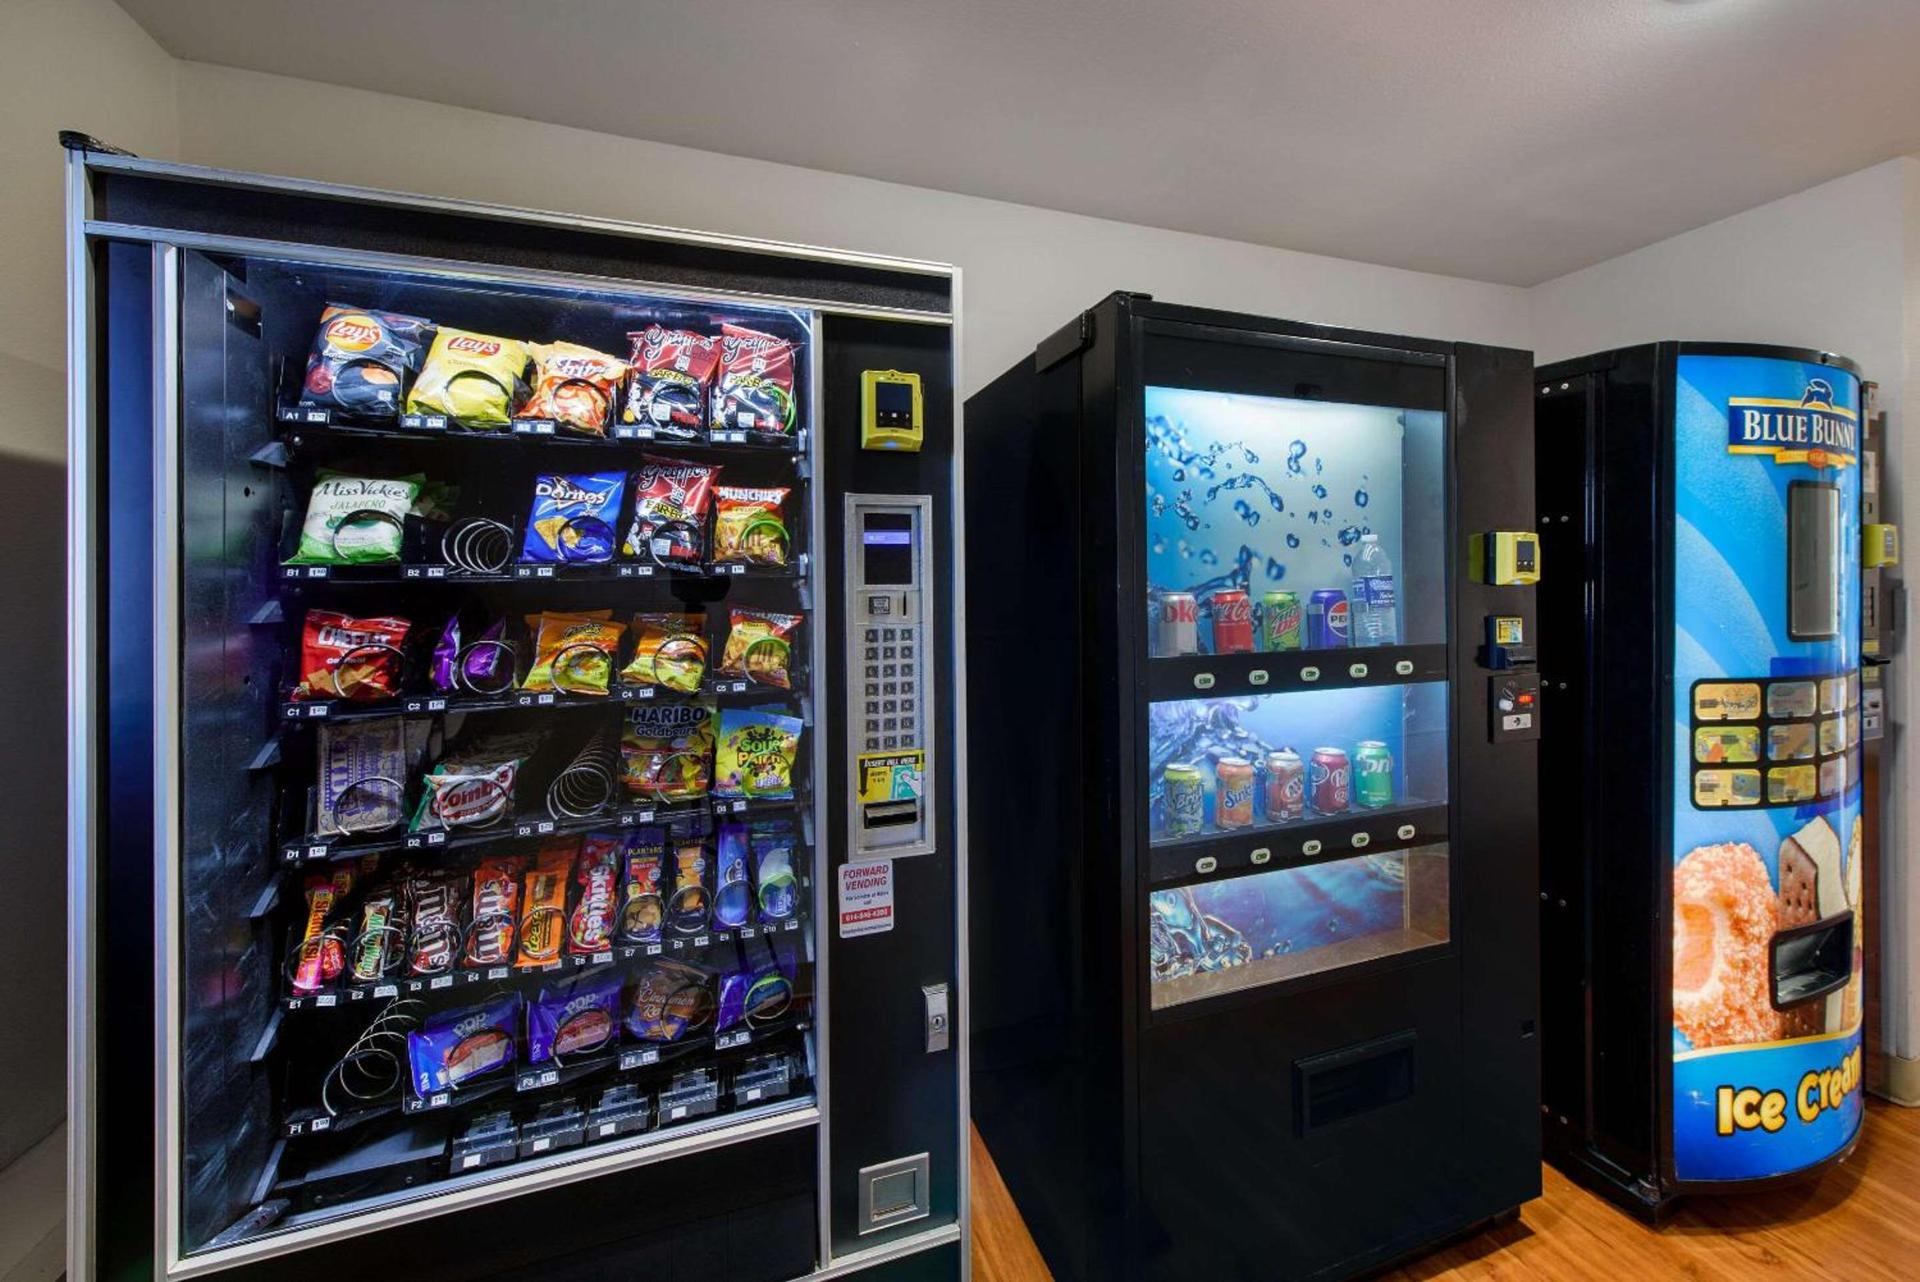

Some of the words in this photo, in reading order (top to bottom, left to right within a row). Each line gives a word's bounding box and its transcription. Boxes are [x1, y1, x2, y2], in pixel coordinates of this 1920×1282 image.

[1743, 409, 1808, 442] BLUE
[316, 482, 358, 497] Miss
[357, 481, 409, 500] Vickie's
[536, 481, 606, 505] Doritos
[287, 708, 300, 717] C1
[408, 703, 421, 711] C2
[632, 707, 709, 723] HARIBO
[741, 739, 781, 752] SOUR
[407, 839, 421, 847] D2
[286, 850, 300, 859] D1
[843, 865, 889, 879] FORWARD
[845, 876, 887, 891] VENDING
[625, 949, 636, 957] E7
[289, 1000, 302, 1009] E1
[1716, 1085, 1787, 1136] Ice
[289, 1124, 303, 1135] F1
